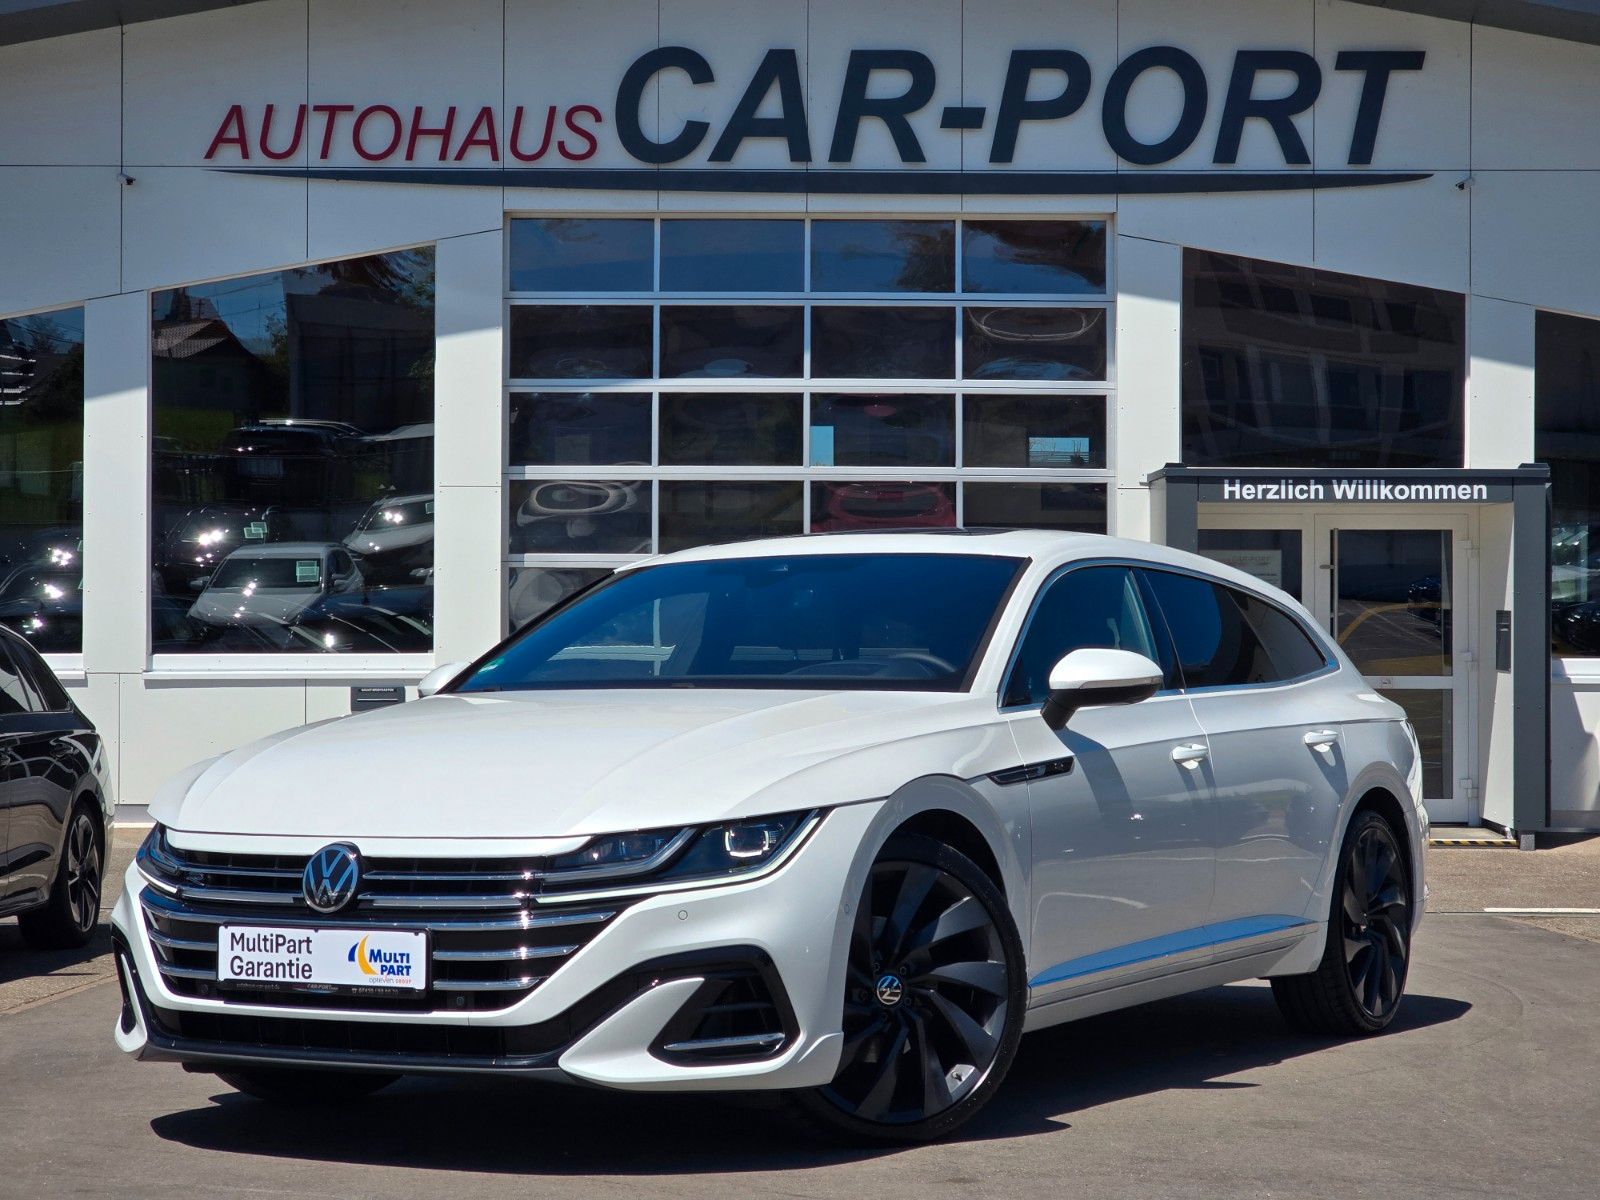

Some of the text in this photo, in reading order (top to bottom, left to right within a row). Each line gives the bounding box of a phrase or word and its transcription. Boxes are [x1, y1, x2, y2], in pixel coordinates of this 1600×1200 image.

[203, 45, 1427, 166] AUTOHAUS CAR-PORT
[1223, 479, 1488, 500] Herzlich Willkommen
[230, 932, 313, 955] MultiPart
[230, 955, 313, 980] Garantie
[380, 964, 412, 976] PART
